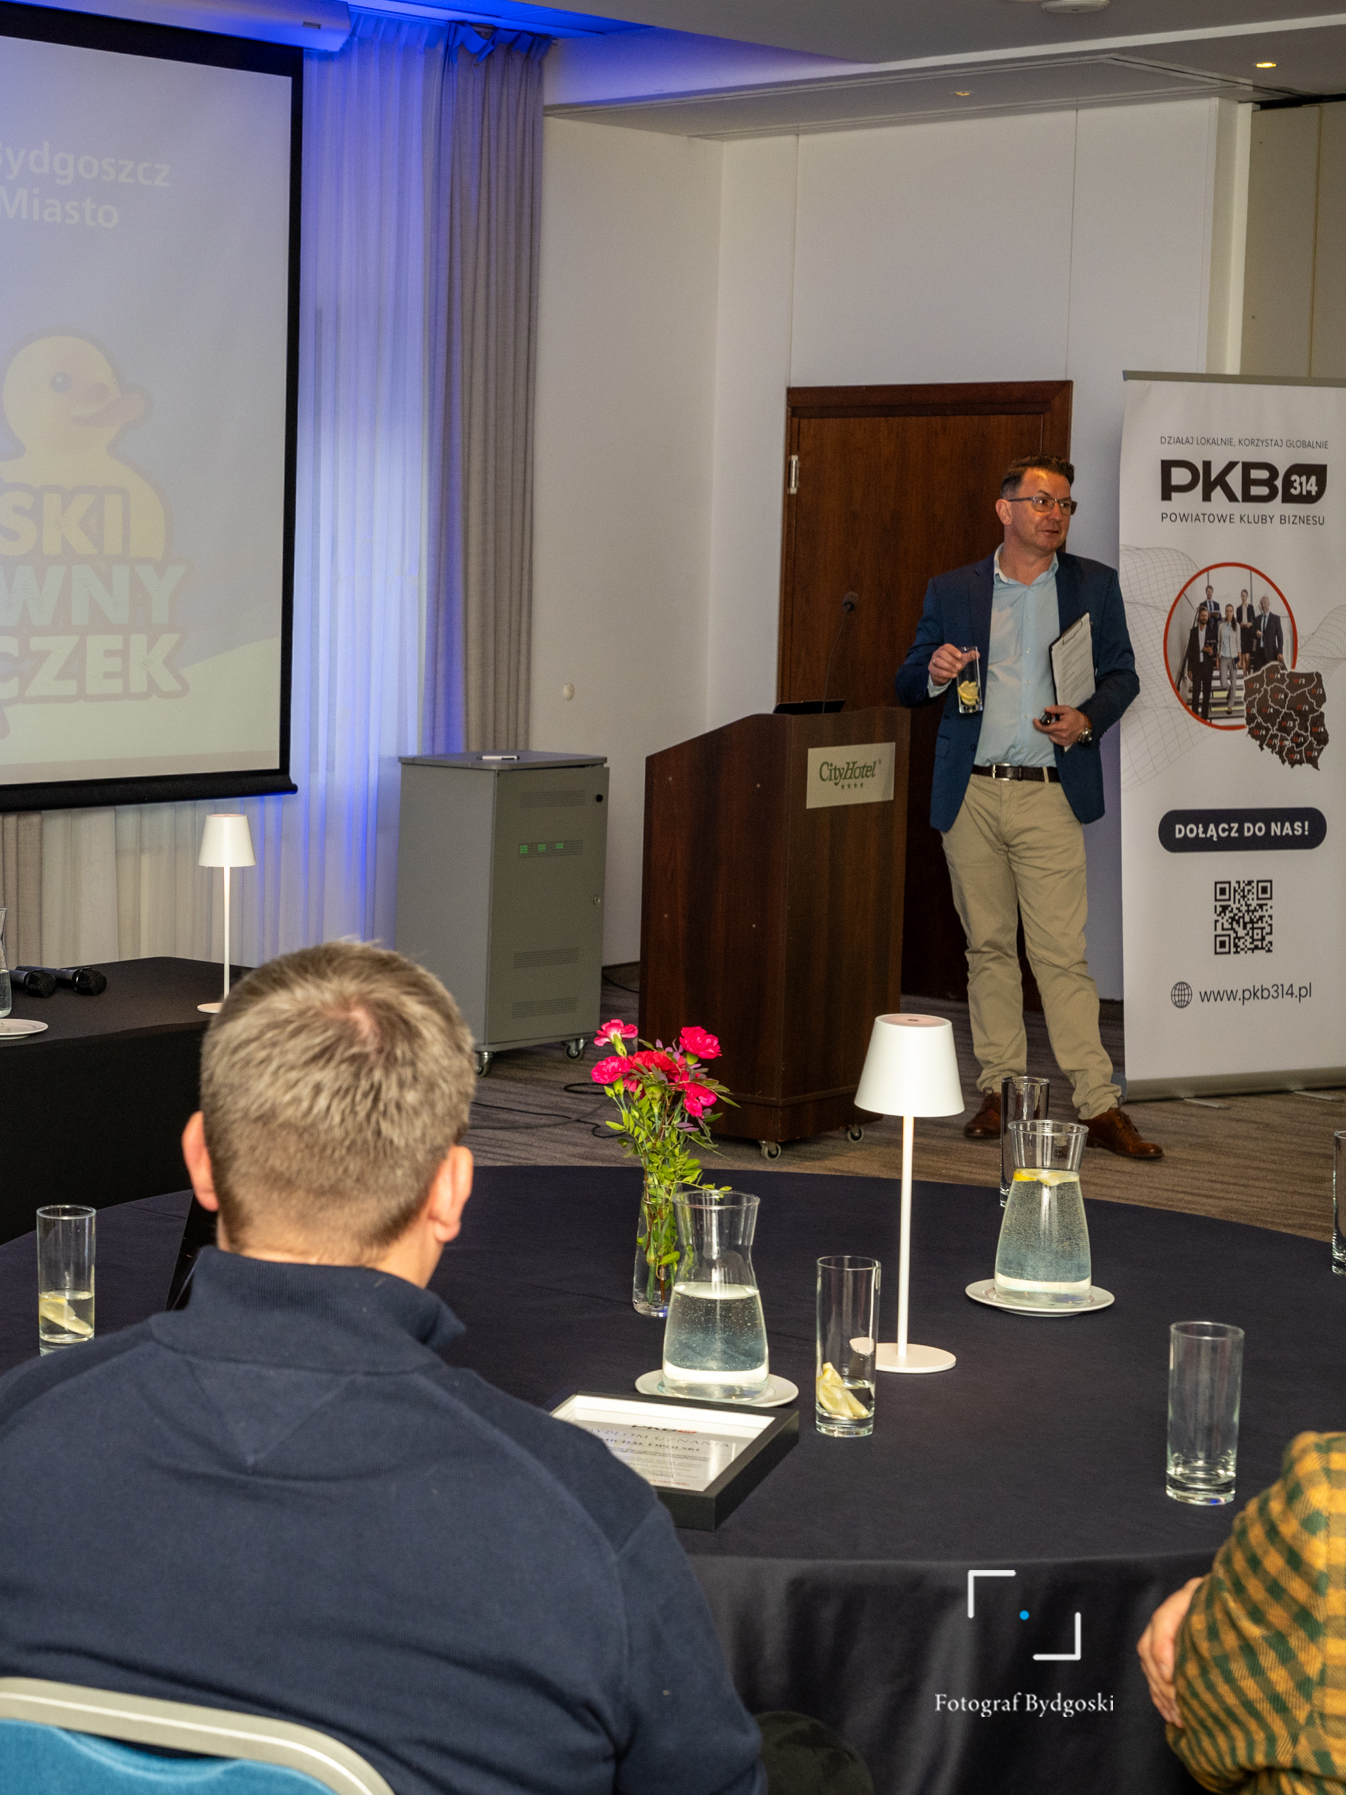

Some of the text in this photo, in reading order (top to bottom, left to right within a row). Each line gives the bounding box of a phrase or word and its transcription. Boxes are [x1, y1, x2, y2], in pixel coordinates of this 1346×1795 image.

[1160, 436, 1329, 449] DZIAŁAJ LOKALNIE, KORZYSTAJ GLOBALNIE
[1160, 459, 1318, 503] PKB 314
[1161, 512, 1325, 526] POWIATOWE KLUBY BIZNESU
[819, 760, 877, 786] CityHotel
[1175, 820, 1309, 841] DOŁĄCZ DO NAS!
[1199, 982, 1312, 1005] www.pkb314.pl
